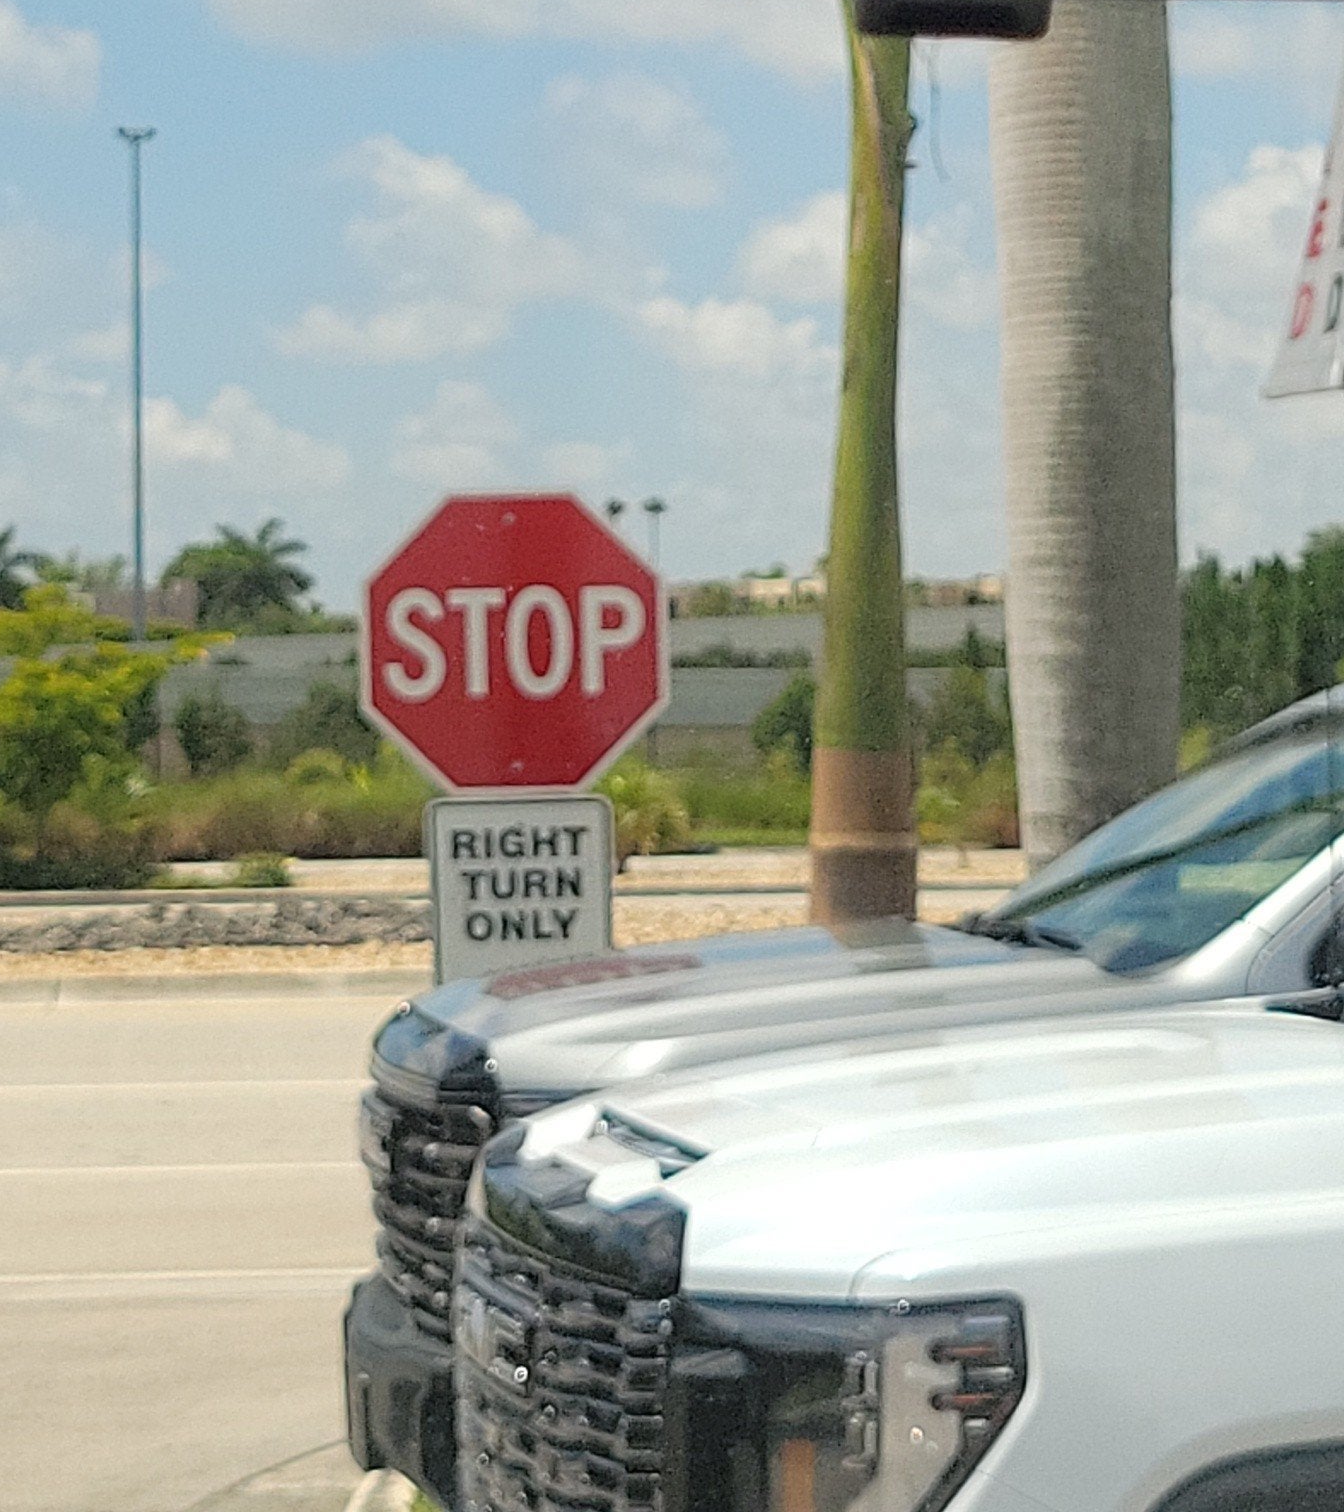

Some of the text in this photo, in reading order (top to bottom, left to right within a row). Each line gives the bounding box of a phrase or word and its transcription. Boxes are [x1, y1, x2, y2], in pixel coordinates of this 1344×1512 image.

[384, 584, 647, 701] STOP
[452, 826, 587, 859] RIGHT
[461, 868, 581, 900] TURN
[467, 909, 578, 941] ONLY
